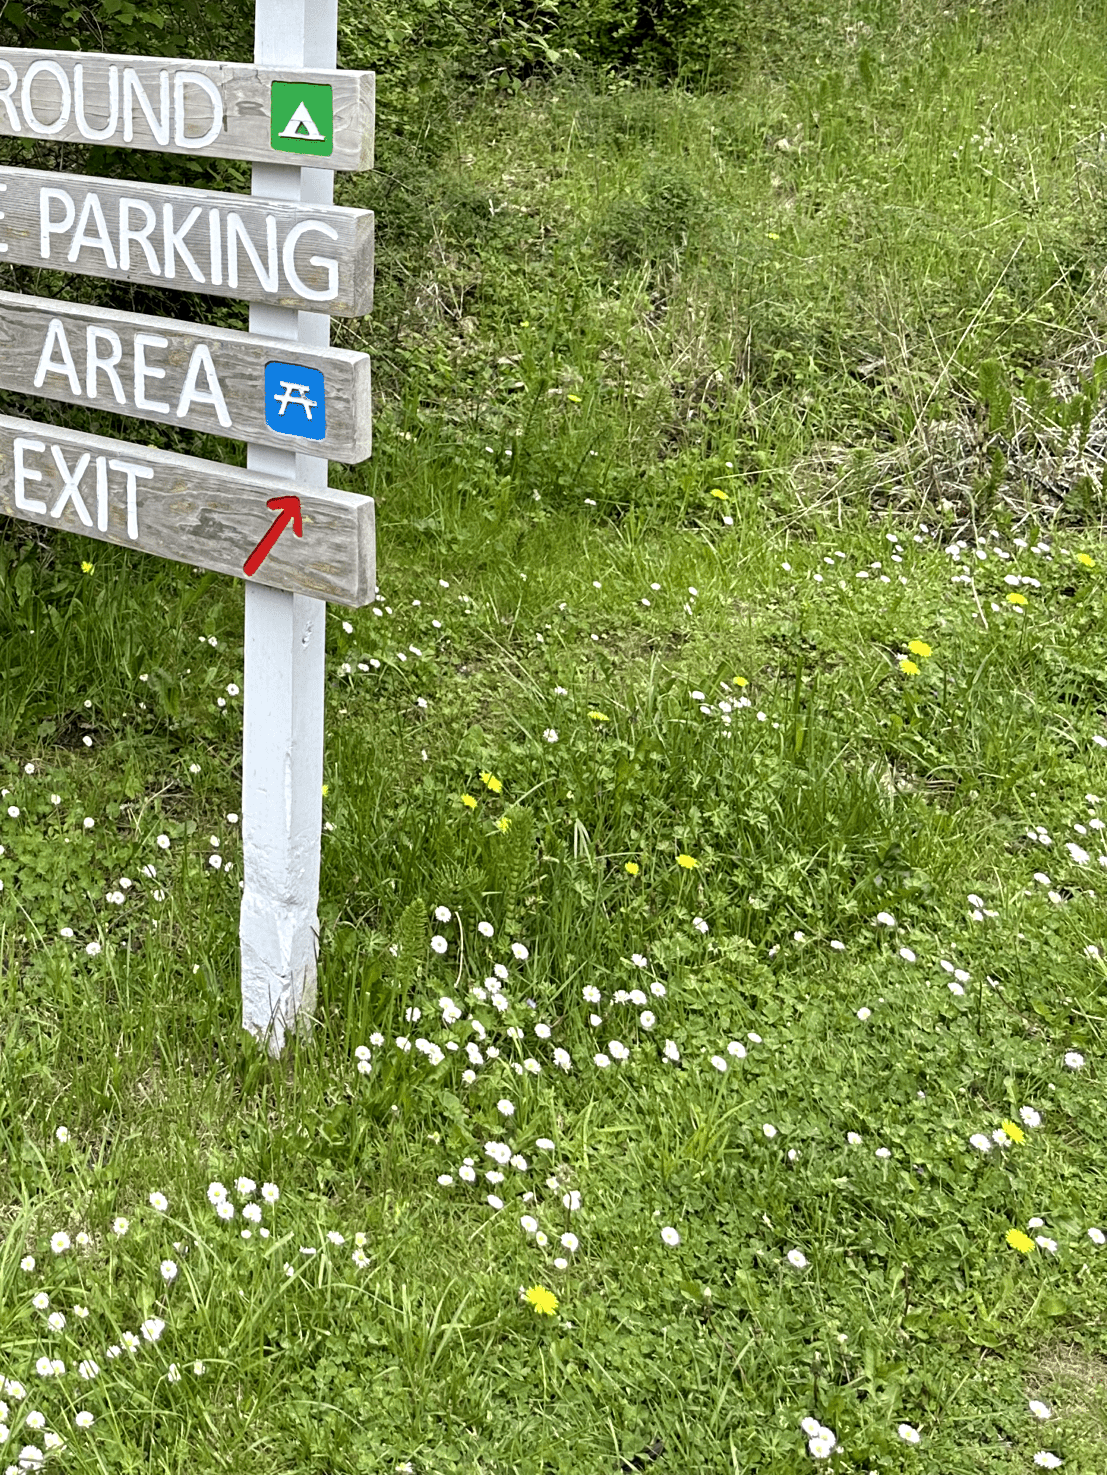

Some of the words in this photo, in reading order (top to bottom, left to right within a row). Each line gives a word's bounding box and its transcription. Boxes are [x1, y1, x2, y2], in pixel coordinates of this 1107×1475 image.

[39, 187, 339, 301] PARKING
[34, 318, 233, 428] AREA
[13, 437, 154, 540] EXIT
